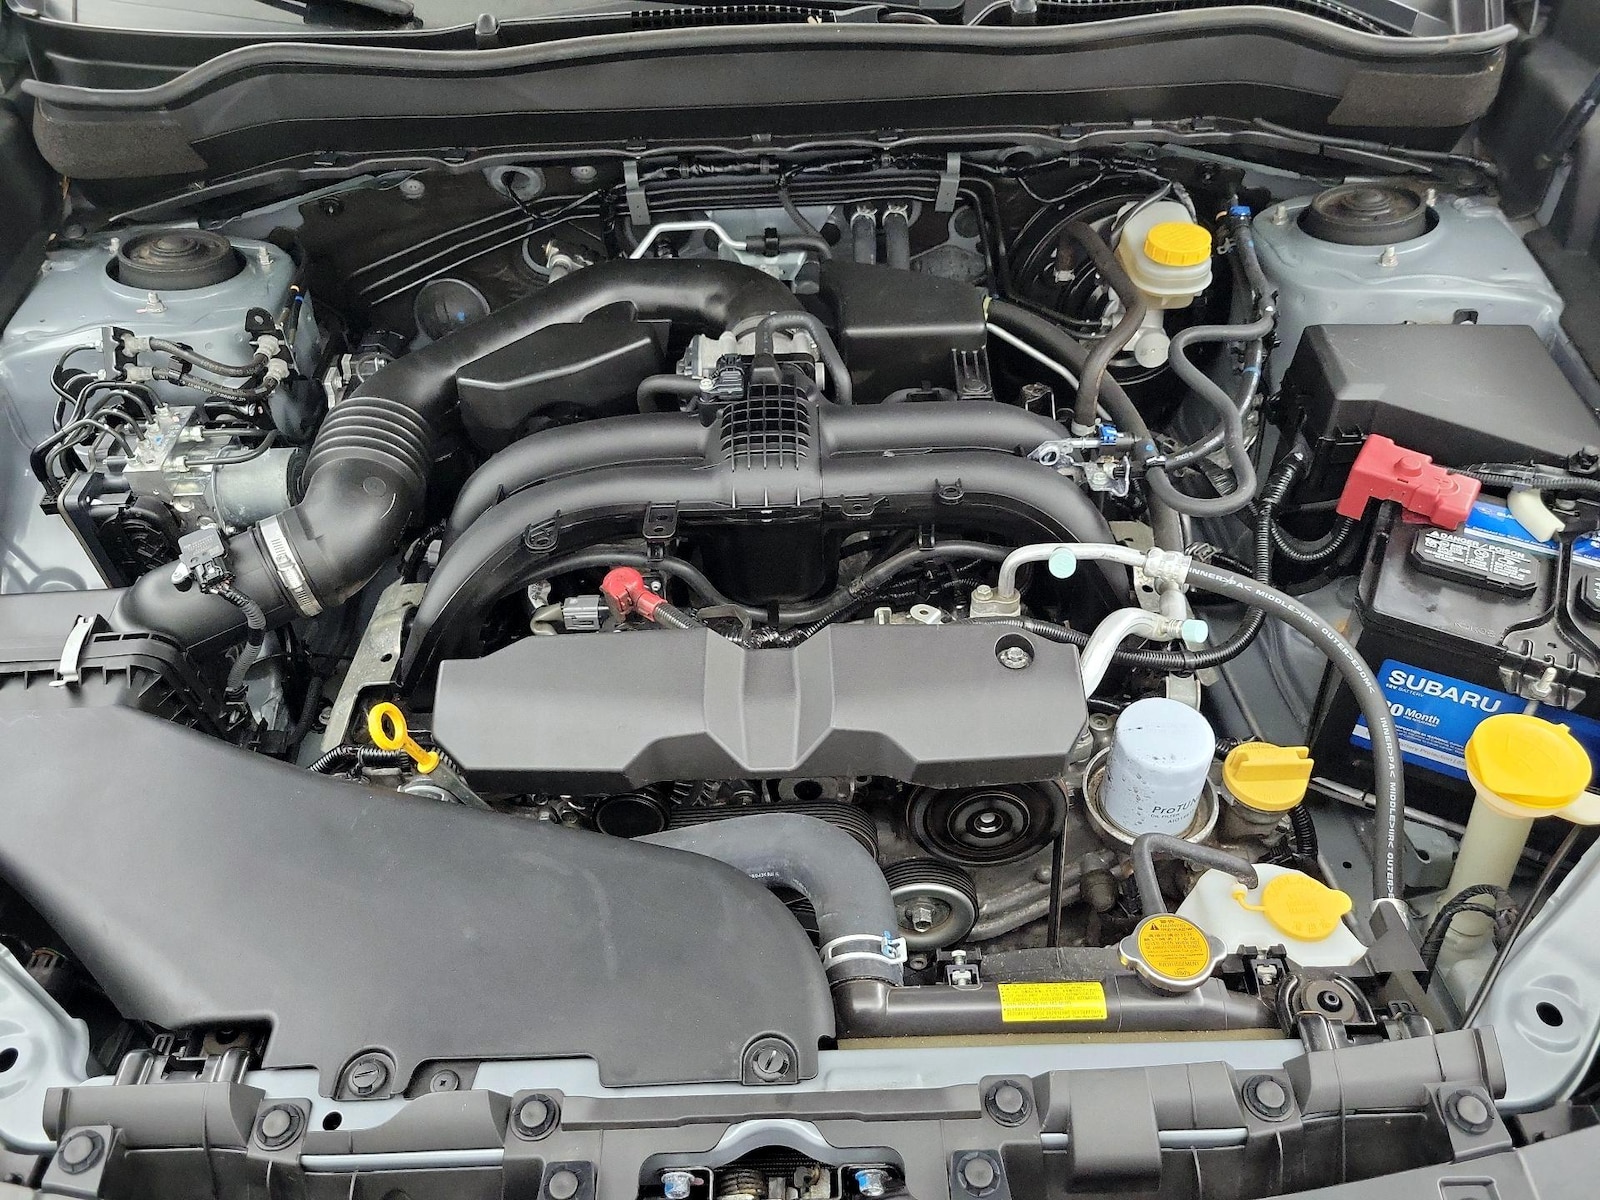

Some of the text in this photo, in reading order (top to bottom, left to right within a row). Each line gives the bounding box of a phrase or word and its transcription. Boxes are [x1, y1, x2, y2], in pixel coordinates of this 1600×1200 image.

[1440, 531, 1480, 548] DANGER
[1488, 543, 1525, 559] POISON
[1388, 669, 1501, 713] SUBARU
[1398, 686, 1425, 698] BATTERY
[1404, 708, 1441, 725] Month
